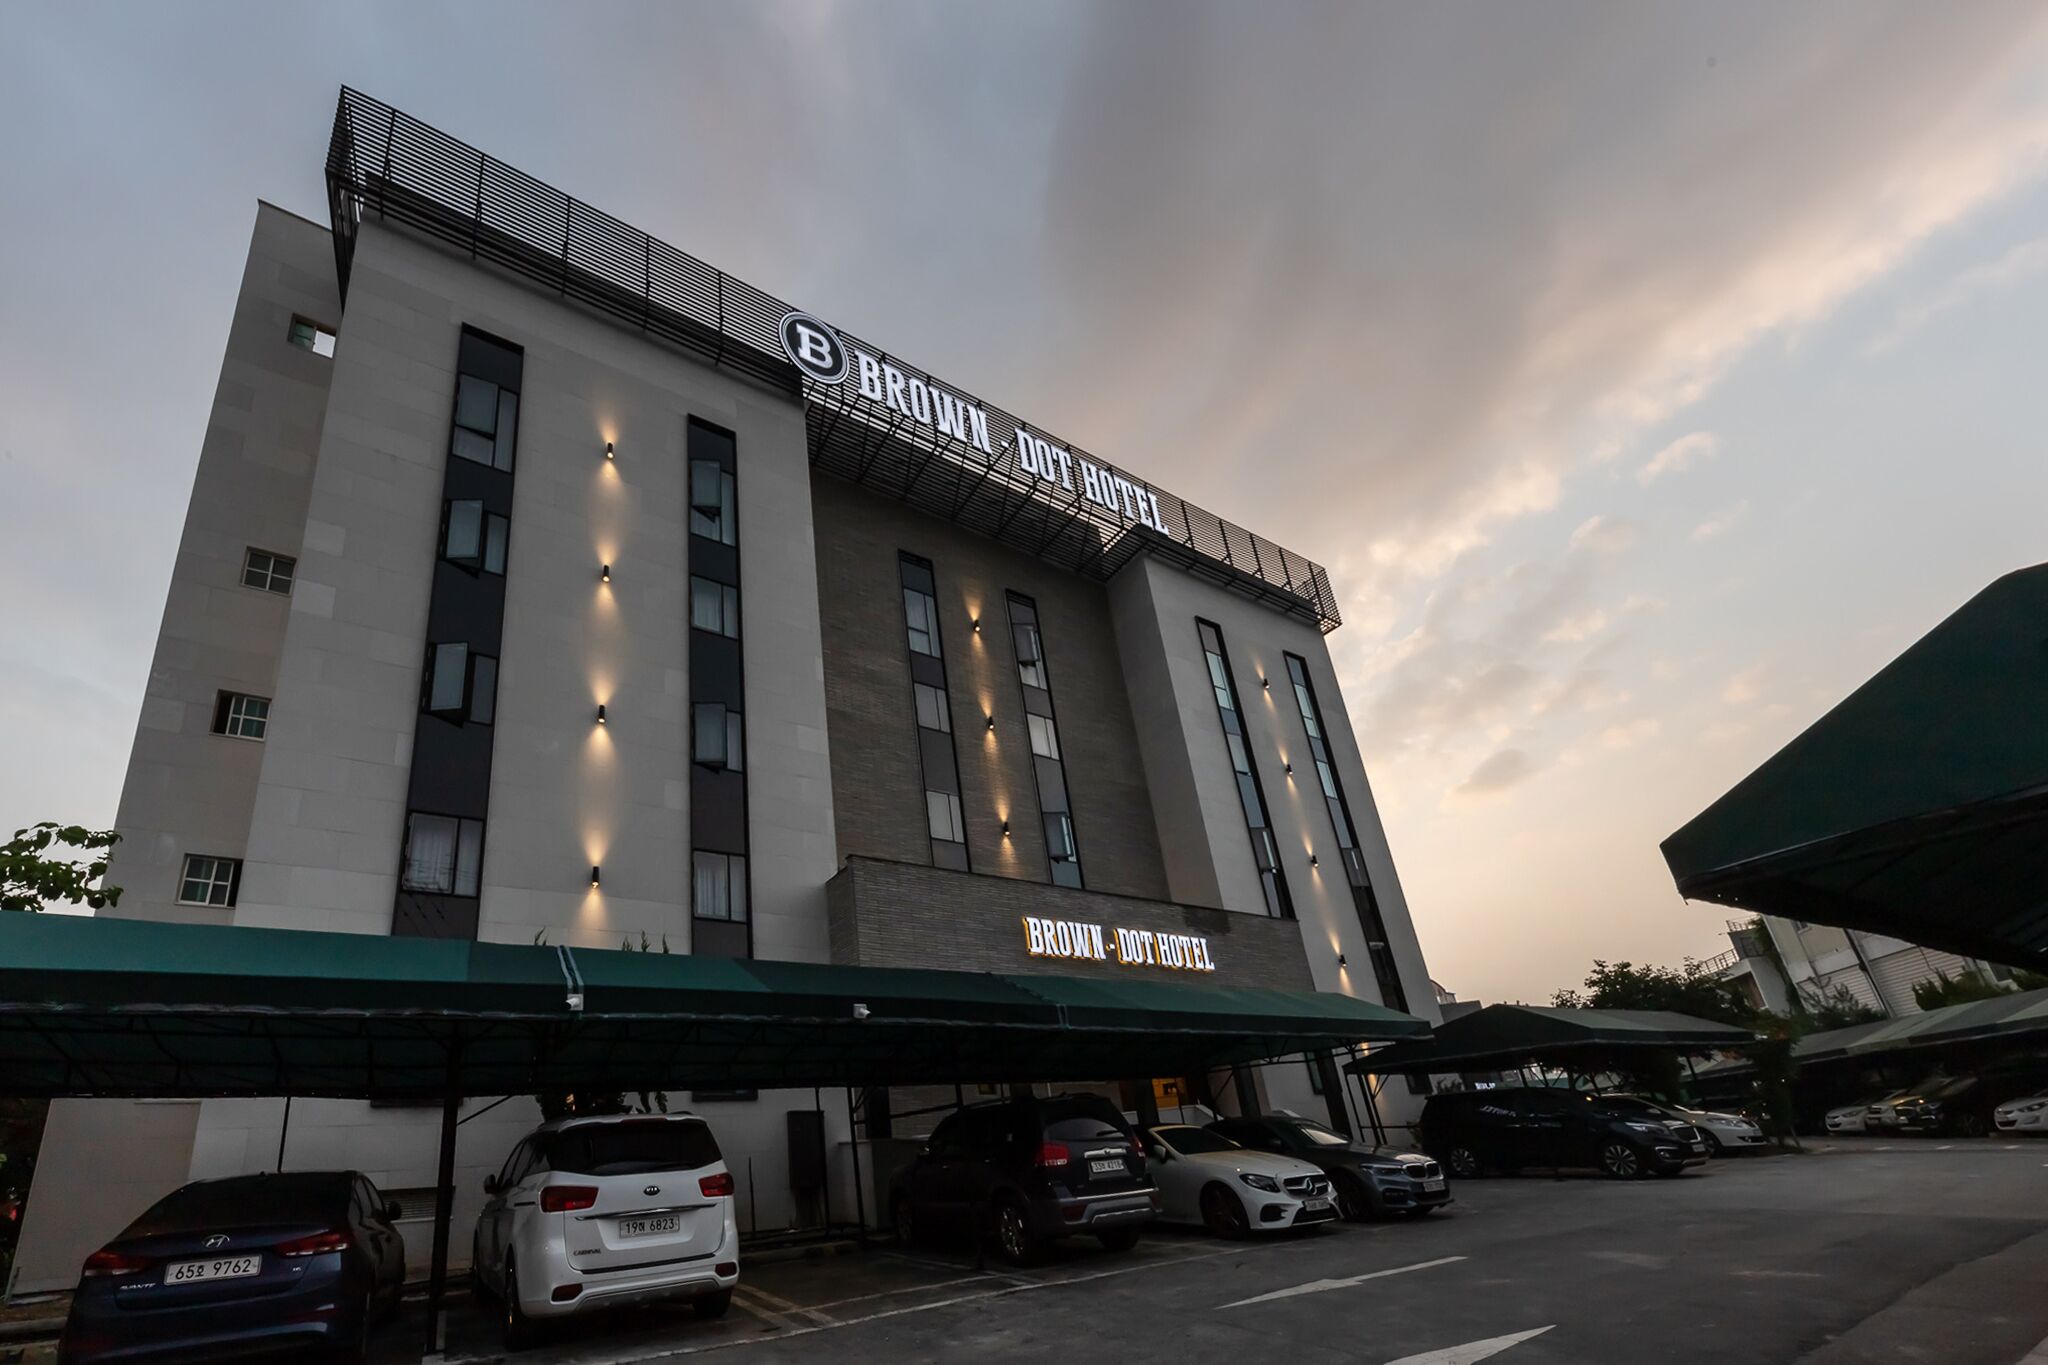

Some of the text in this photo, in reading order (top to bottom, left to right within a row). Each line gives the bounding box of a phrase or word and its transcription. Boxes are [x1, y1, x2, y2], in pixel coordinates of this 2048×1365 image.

[796, 323, 834, 369] B
[854, 349, 993, 455] BROWN
[1015, 427, 1074, 493] DOT
[1079, 458, 1169, 535] HOTEL
[1023, 916, 1107, 961] BROWN
[1115, 927, 1155, 964] DOT
[1156, 931, 1215, 971] HOTEL
[650, 1218, 675, 1232] 6823
[213, 1258, 251, 1276] 9762
